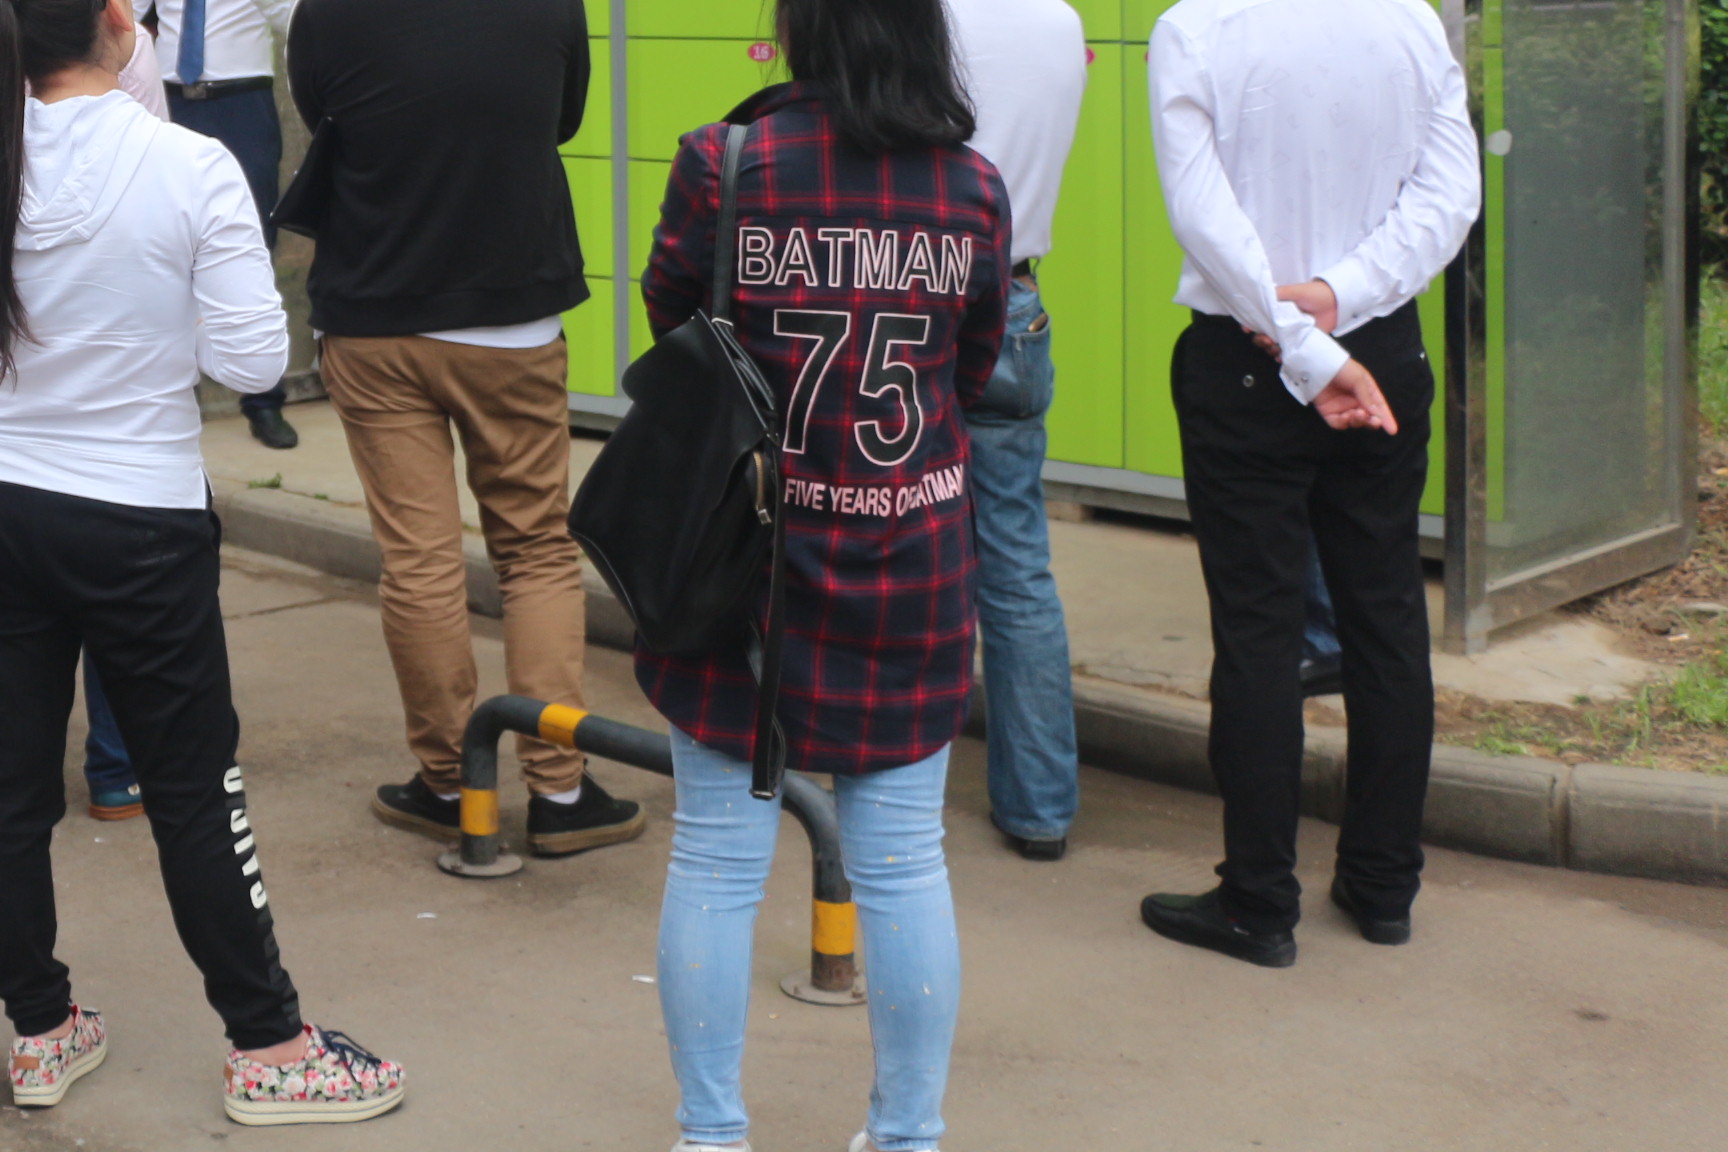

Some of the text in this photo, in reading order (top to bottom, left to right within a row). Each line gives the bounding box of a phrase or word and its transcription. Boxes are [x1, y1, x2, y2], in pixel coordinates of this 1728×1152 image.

[738, 226, 972, 295] BATMAN
[774, 309, 931, 467] 75
[784, 478, 826, 510] FIVE
[829, 486, 892, 517] YEARS
[910, 464, 964, 509] ATMAN
